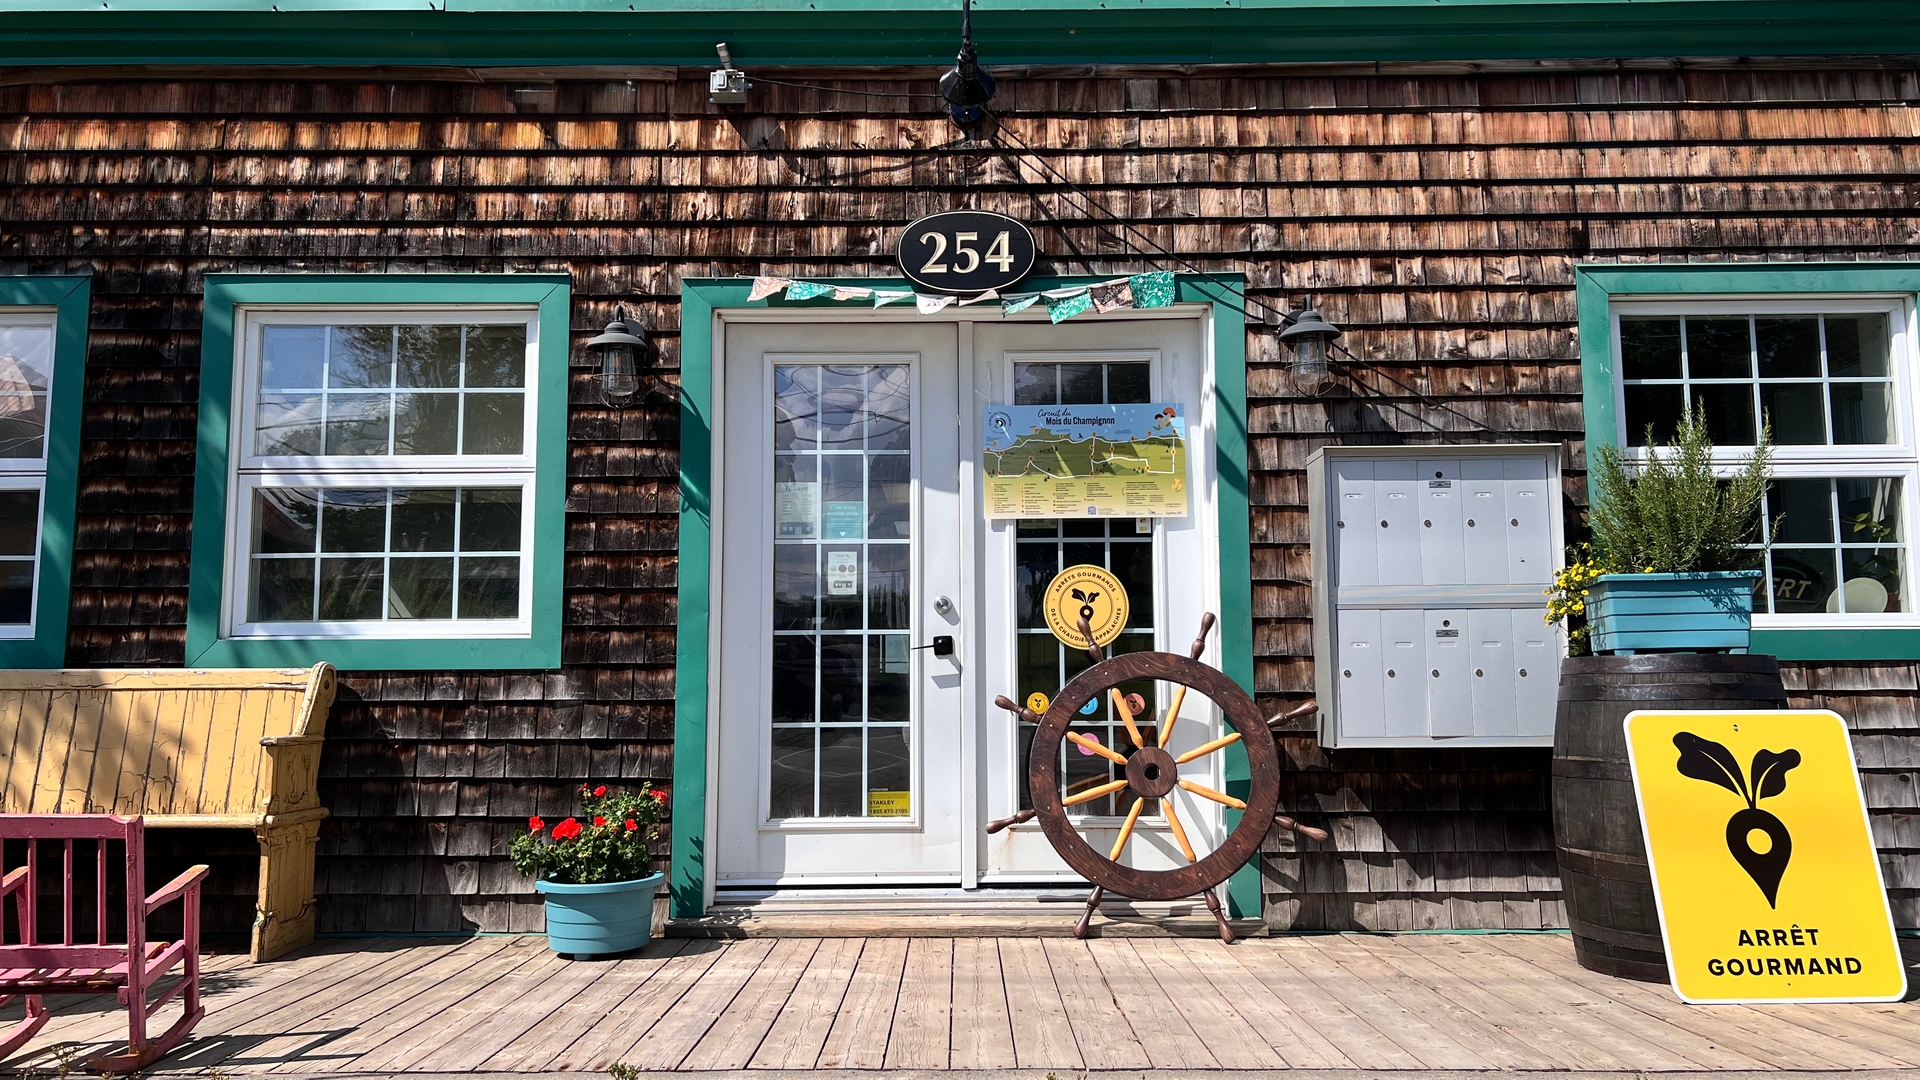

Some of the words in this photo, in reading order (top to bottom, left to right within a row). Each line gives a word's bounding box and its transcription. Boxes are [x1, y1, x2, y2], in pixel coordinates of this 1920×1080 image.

[920, 230, 1014, 274] 254
[1037, 408, 1061, 418] Circuit
[1061, 407, 1071, 417] du
[1045, 416, 1062, 426] Mois
[1063, 416, 1072, 425] du
[1072, 416, 1115, 427] Champignon
[1055, 574, 1076, 593] ARRÊTS
[1077, 571, 1116, 593] GOURMANDS
[1050, 608, 1057, 617] DE
[1053, 616, 1060, 626] LA
[1738, 924, 1819, 947] ARRÊT
[1707, 957, 1862, 977] GOURMAND
